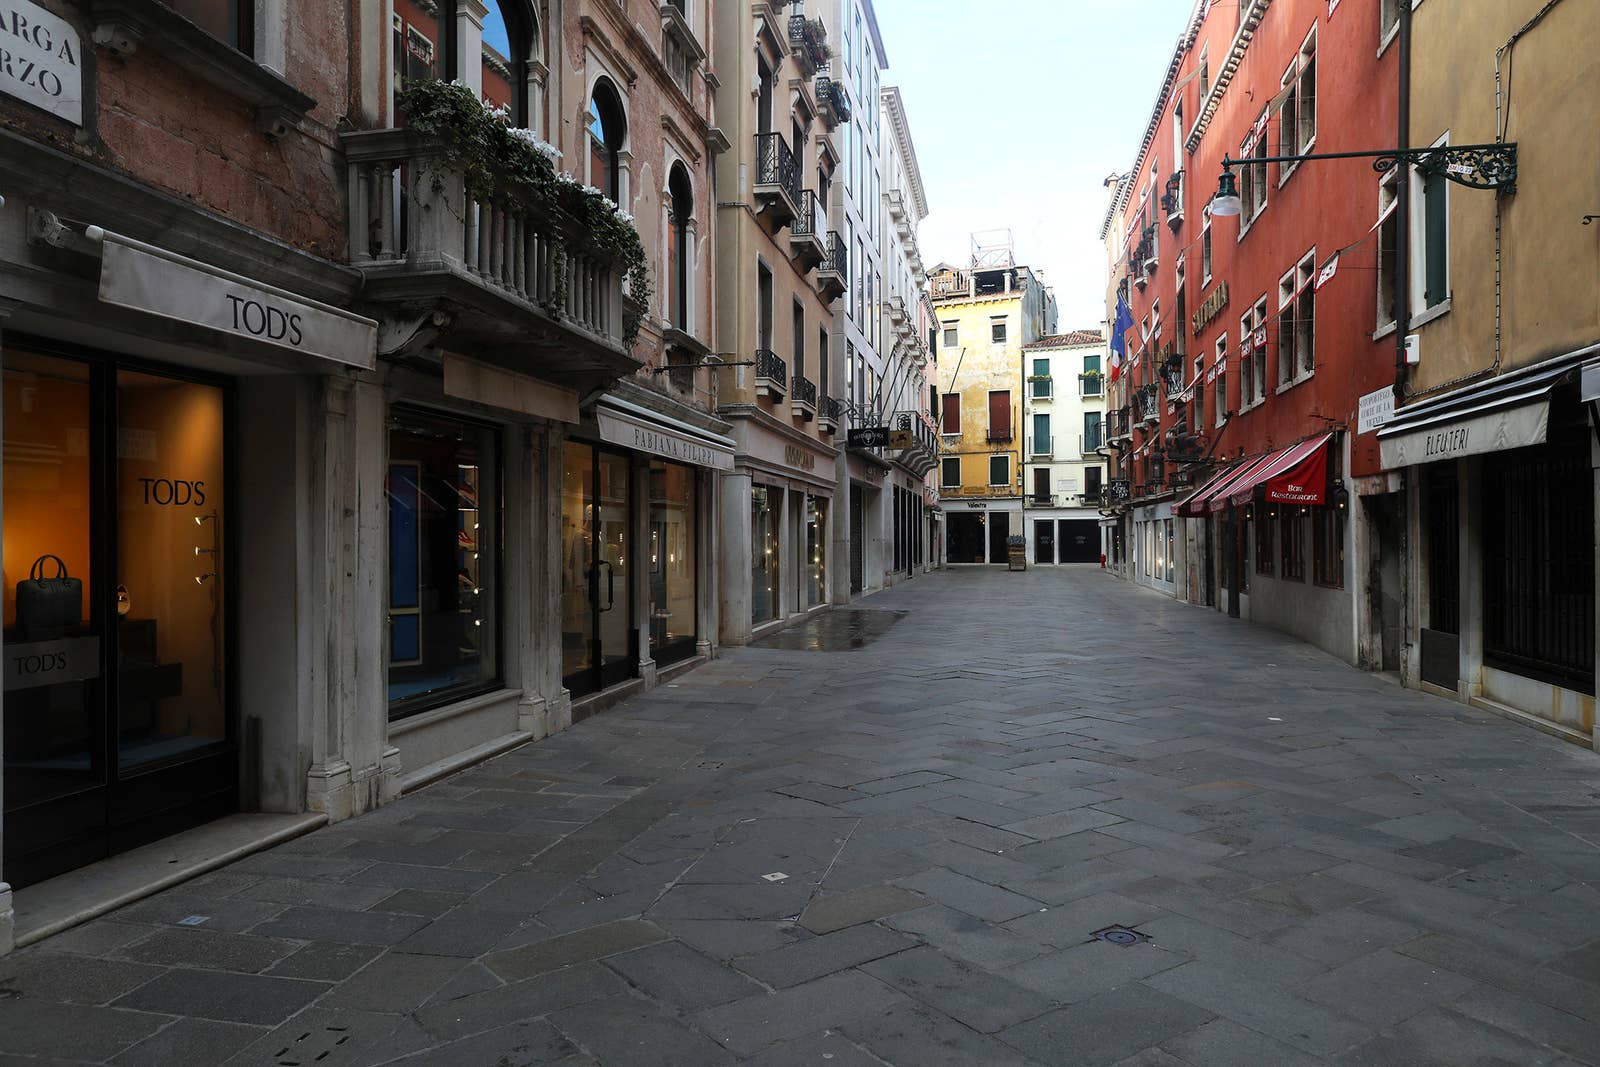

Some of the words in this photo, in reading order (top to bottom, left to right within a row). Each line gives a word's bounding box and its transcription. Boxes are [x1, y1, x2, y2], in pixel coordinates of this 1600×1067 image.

[226, 294, 302, 346] TOD'S
[633, 429, 678, 456] FABIANA
[683, 443, 715, 466] FILIPPI
[1426, 427, 1470, 456] ELEUTERI
[138, 478, 205, 506] TOD'S
[14, 652, 67, 675] TOD'S
